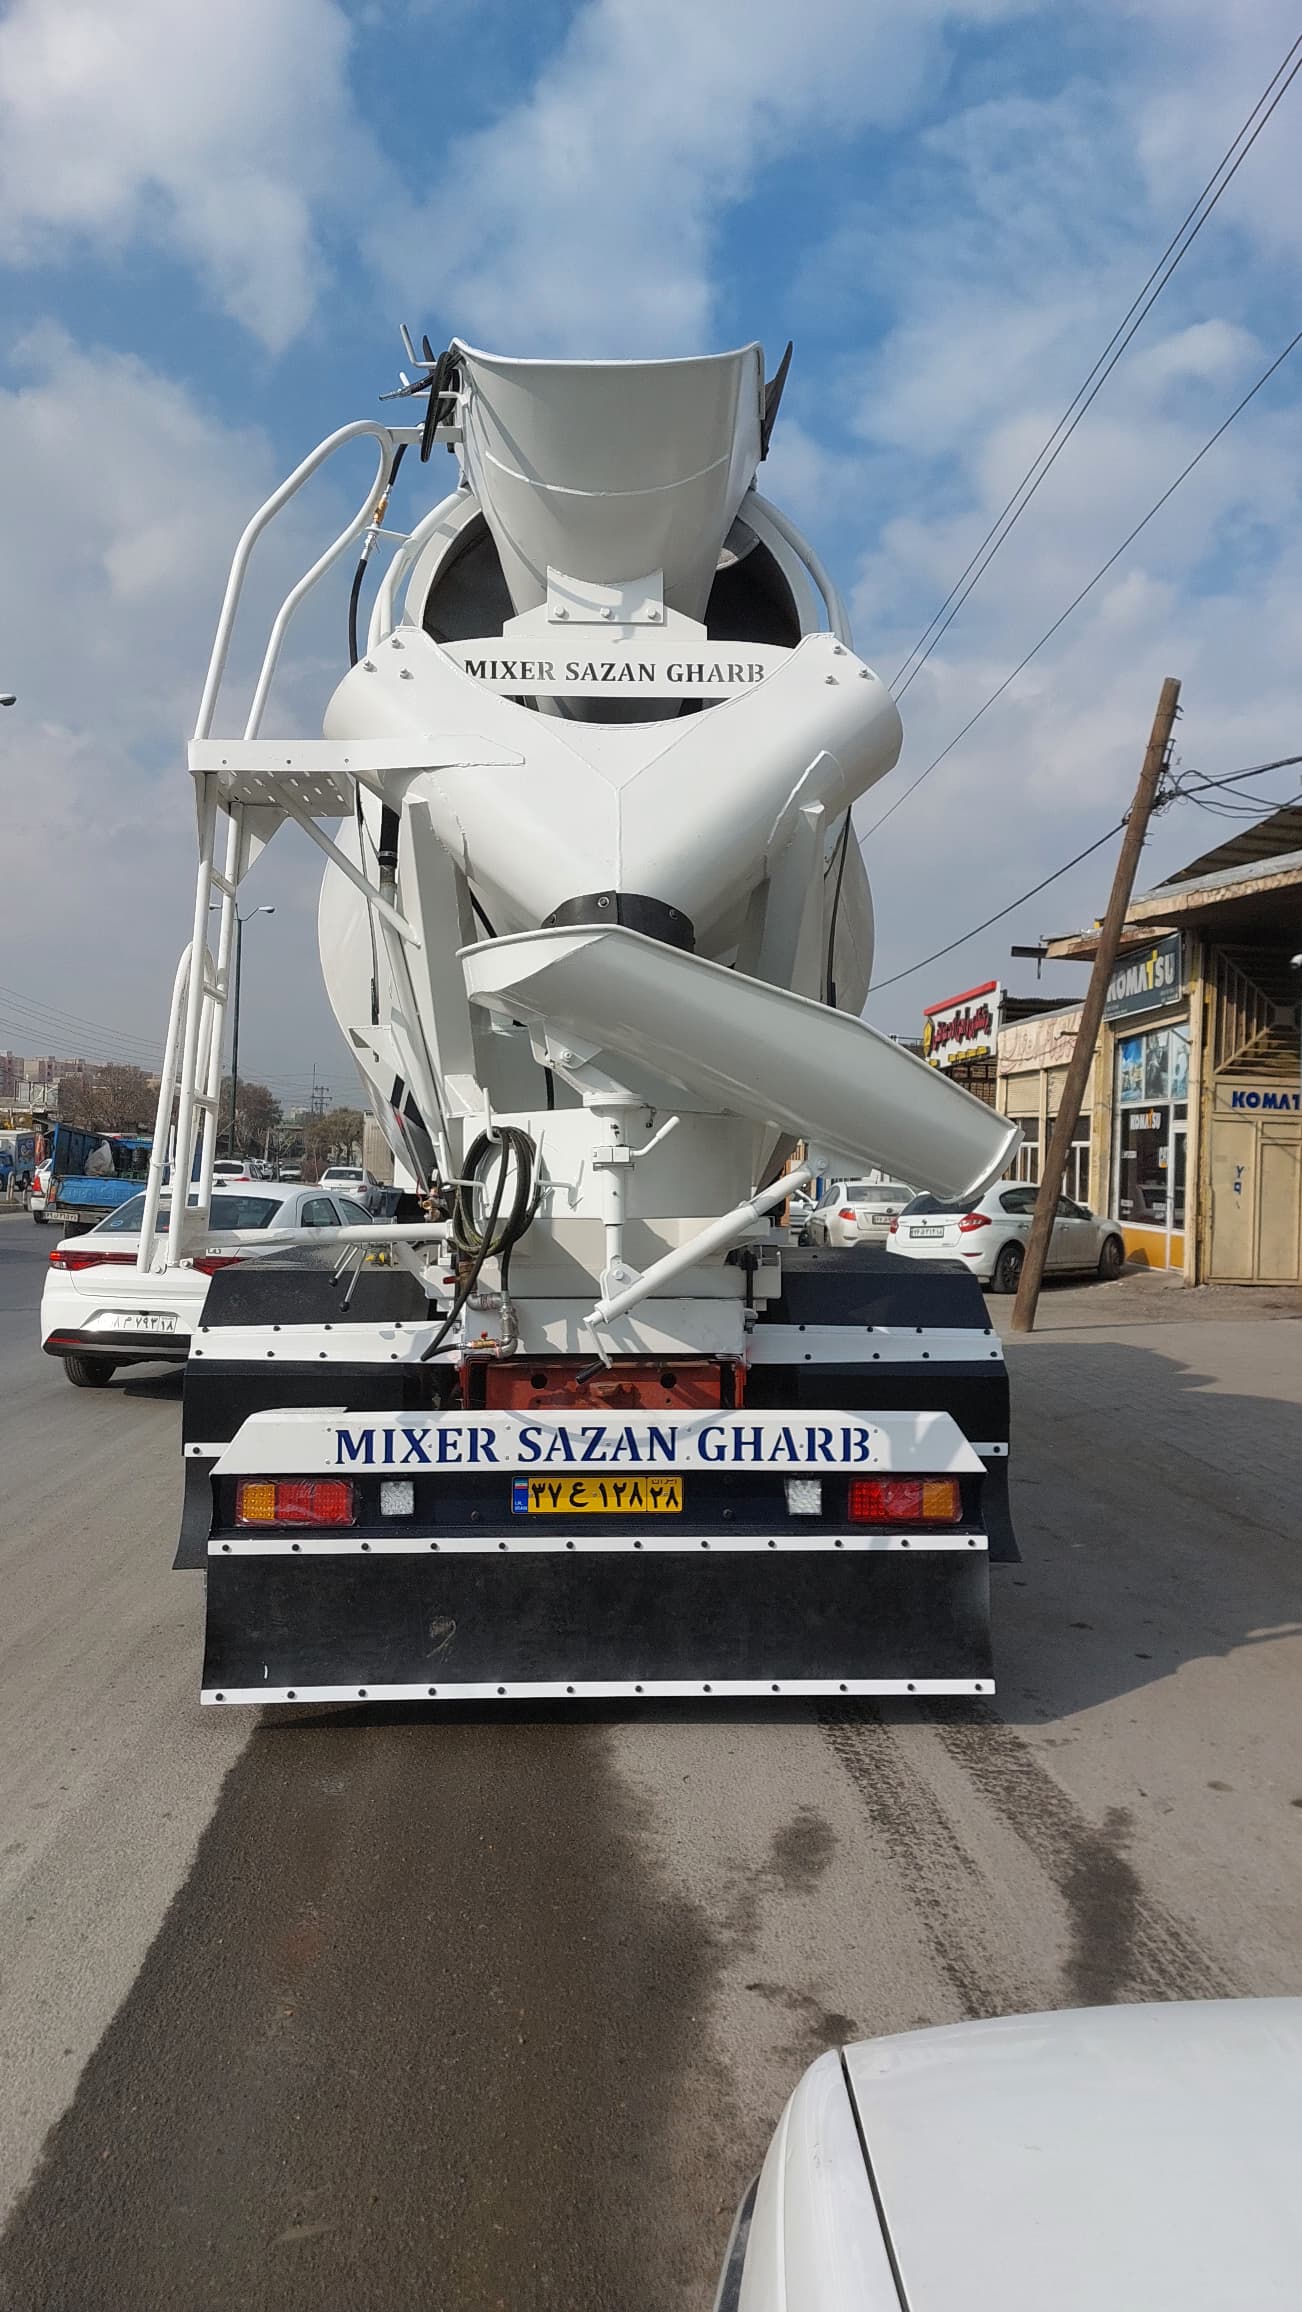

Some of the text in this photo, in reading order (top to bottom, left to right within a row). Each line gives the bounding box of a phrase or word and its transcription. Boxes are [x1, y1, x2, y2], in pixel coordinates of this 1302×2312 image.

[463, 659, 765, 683] MIXER SAZAN GHARB
[335, 1425, 871, 1465] MIXER SAZAN GHARB
